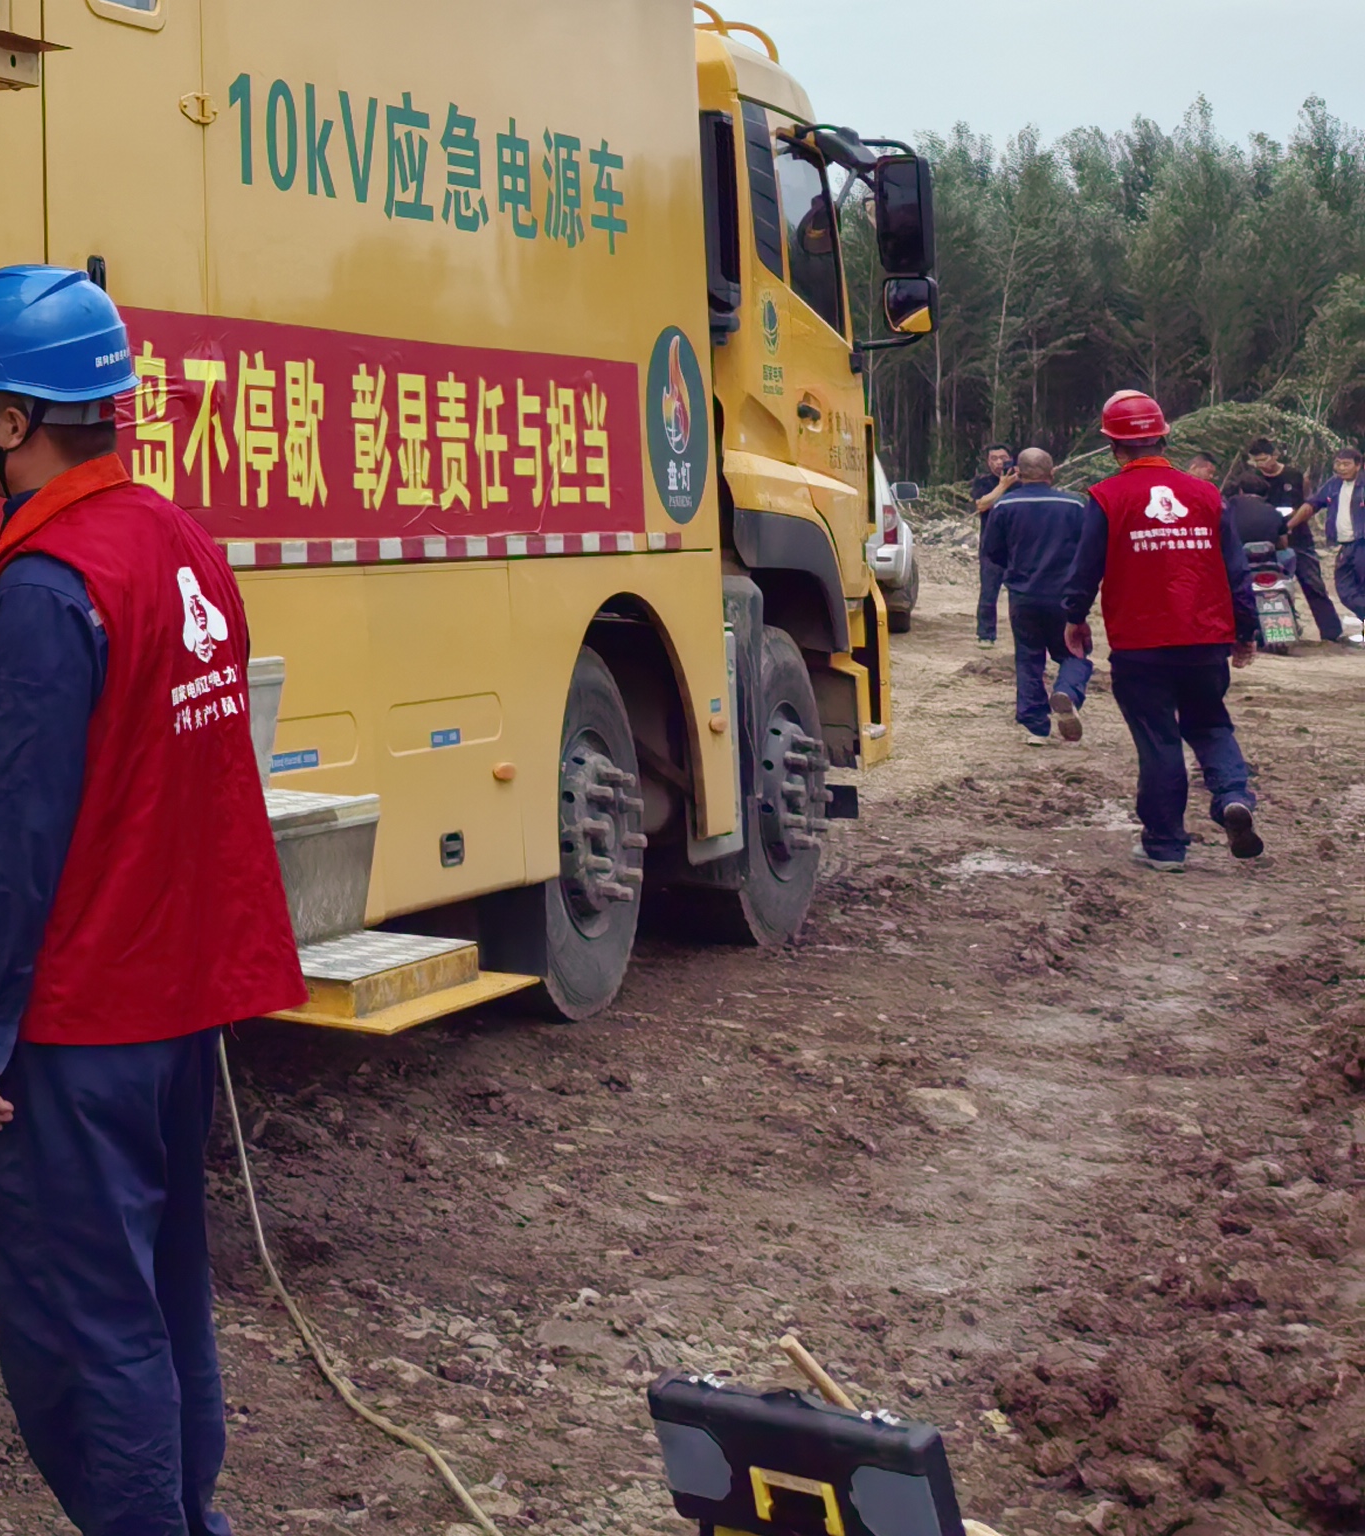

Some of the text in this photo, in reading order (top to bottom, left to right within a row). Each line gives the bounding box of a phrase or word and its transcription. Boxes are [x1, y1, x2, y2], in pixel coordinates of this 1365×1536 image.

[228, 72, 628, 256] 10kV应急电源车
[351, 362, 612, 510] 彰显责任与担当
